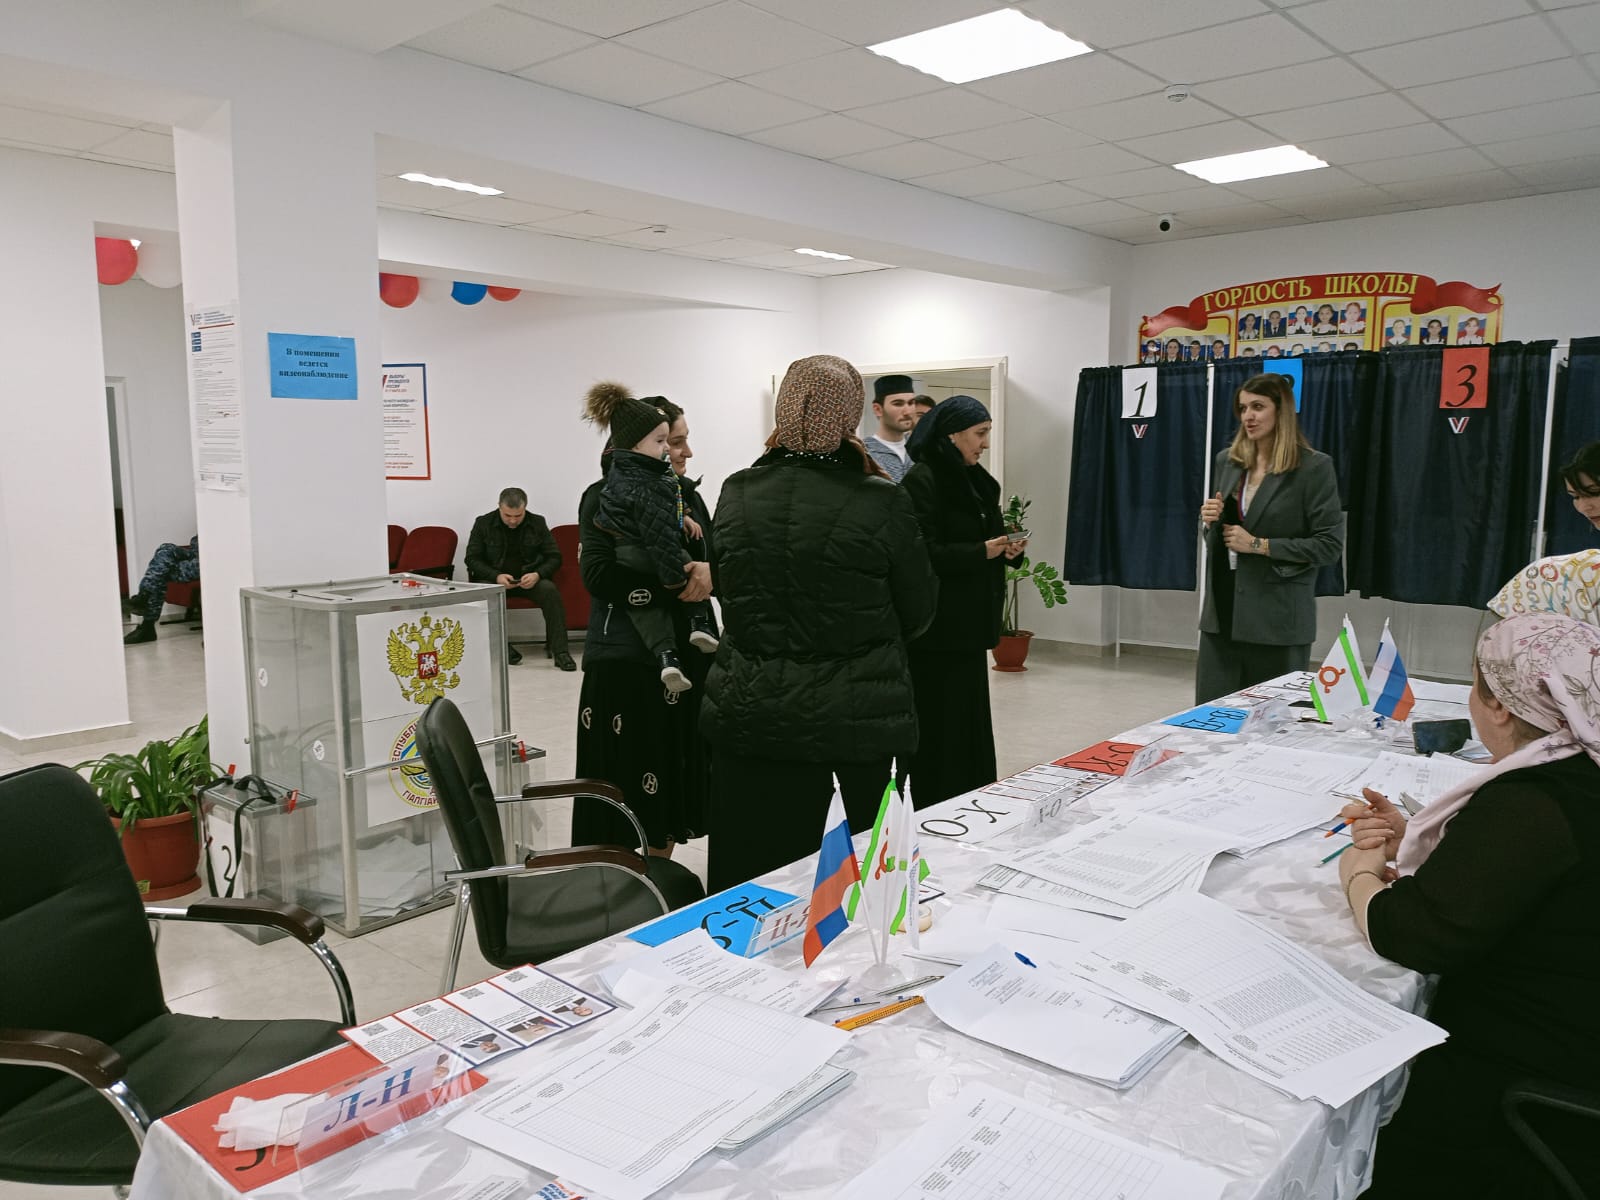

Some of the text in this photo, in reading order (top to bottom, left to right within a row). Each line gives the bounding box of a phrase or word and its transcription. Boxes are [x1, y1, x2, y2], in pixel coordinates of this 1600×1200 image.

[1203, 274, 1418, 311] ГОРДОСТЬ ШКОЛЫ
[286, 347, 293, 356] В
[278, 370, 349, 379] видеонаблюдение
[1445, 364, 1477, 408] 3
[1128, 381, 1148, 418] 1
[323, 1066, 416, 1132] Л-Н
